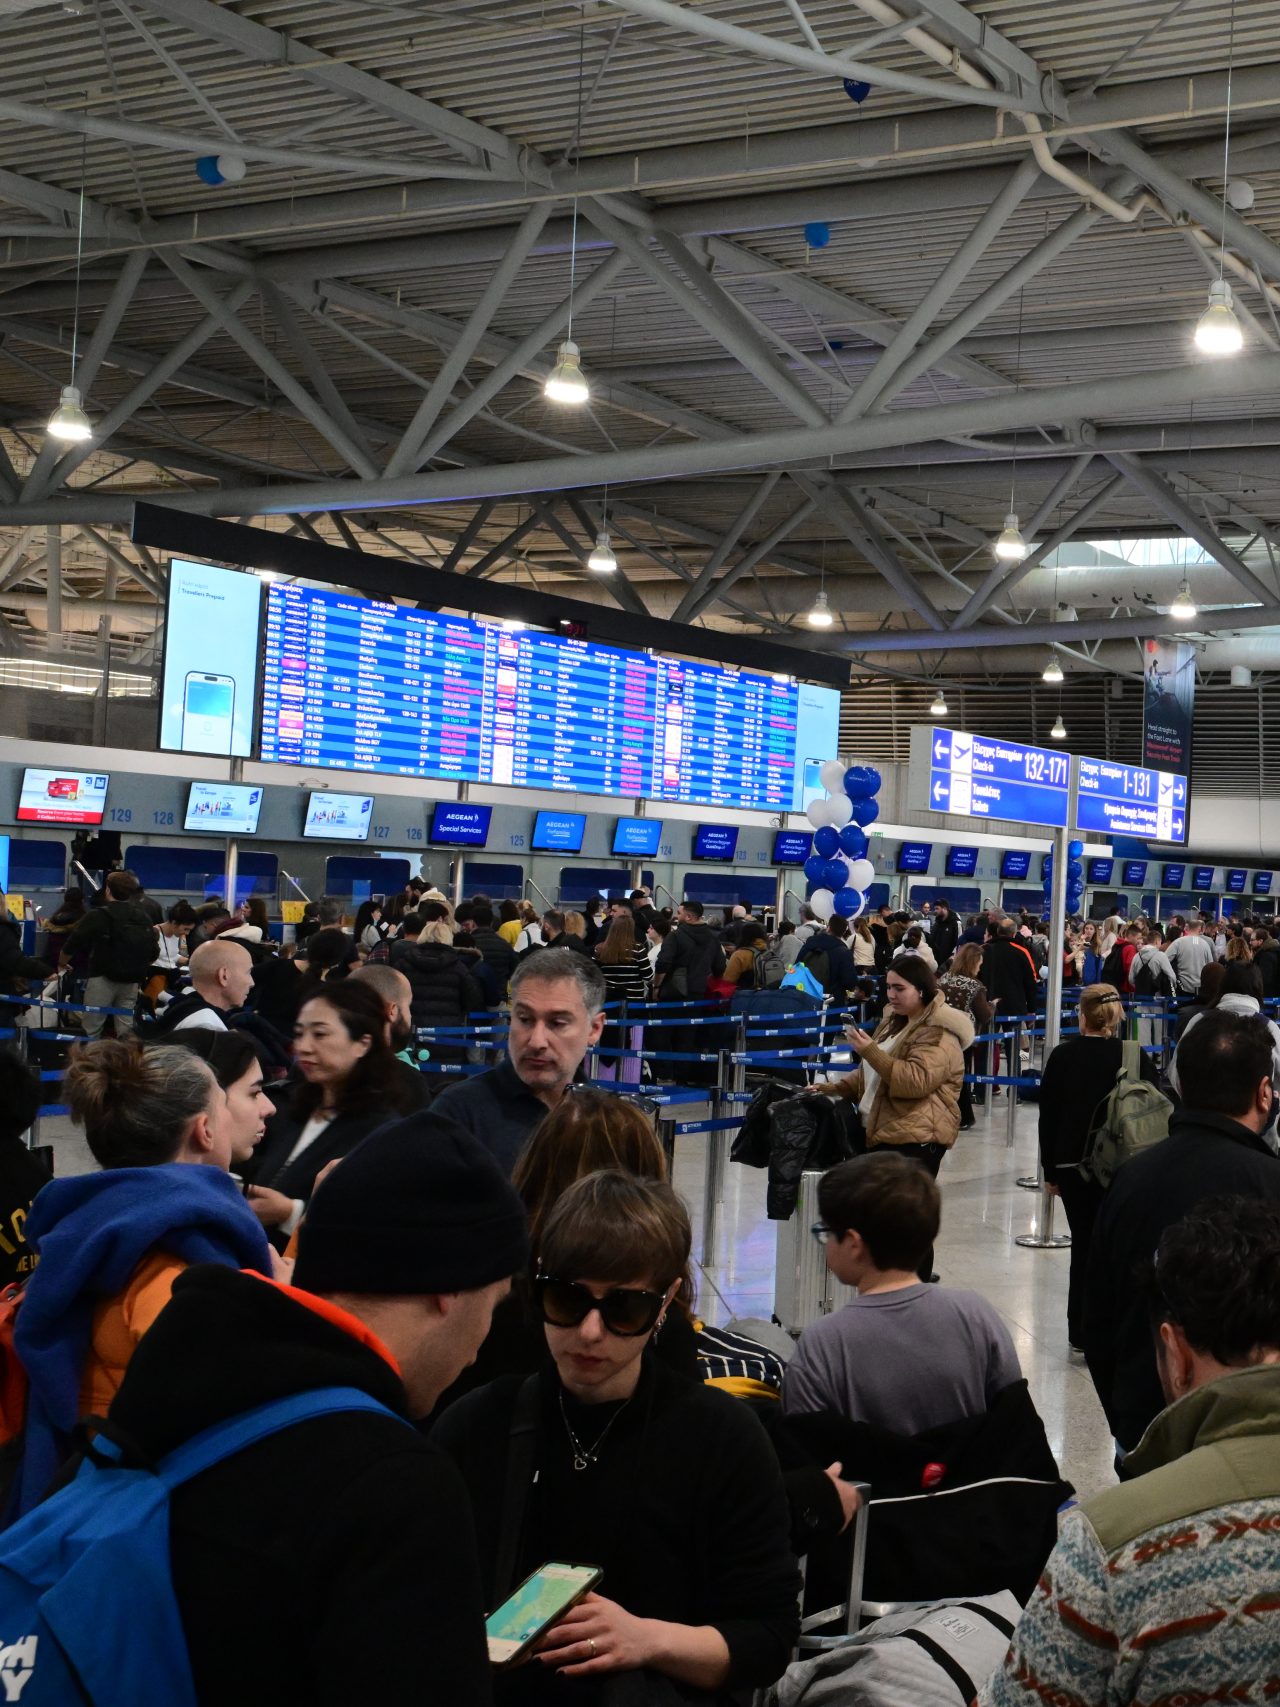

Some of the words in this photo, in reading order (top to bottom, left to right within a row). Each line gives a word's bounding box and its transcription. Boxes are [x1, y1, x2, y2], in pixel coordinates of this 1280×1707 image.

[182, 588, 204, 597] Travellers
[206, 592, 225, 600] Prepaid
[1148, 722, 1158, 730] Head
[1158, 724, 1173, 735] straight
[1163, 735, 1172, 743] Lane
[973, 759, 993, 772] Check-in
[1025, 752, 1067, 785] 132-171
[1080, 776, 1098, 788] Check-in
[1123, 770, 1150, 797] 1-131
[973, 783, 1000, 800] Τουαλέτες
[972, 800, 988, 812] Toilets
[110, 808, 132, 822] 129
[153, 812, 174, 825] 128
[446, 813, 472, 822] AEGEAN
[374, 826, 390, 838] 127
[406, 828, 423, 840] 126
[439, 824, 459, 834] Special
[460, 826, 482, 834] Services
[510, 835, 524, 846] 125
[660, 846, 672, 856] 124
